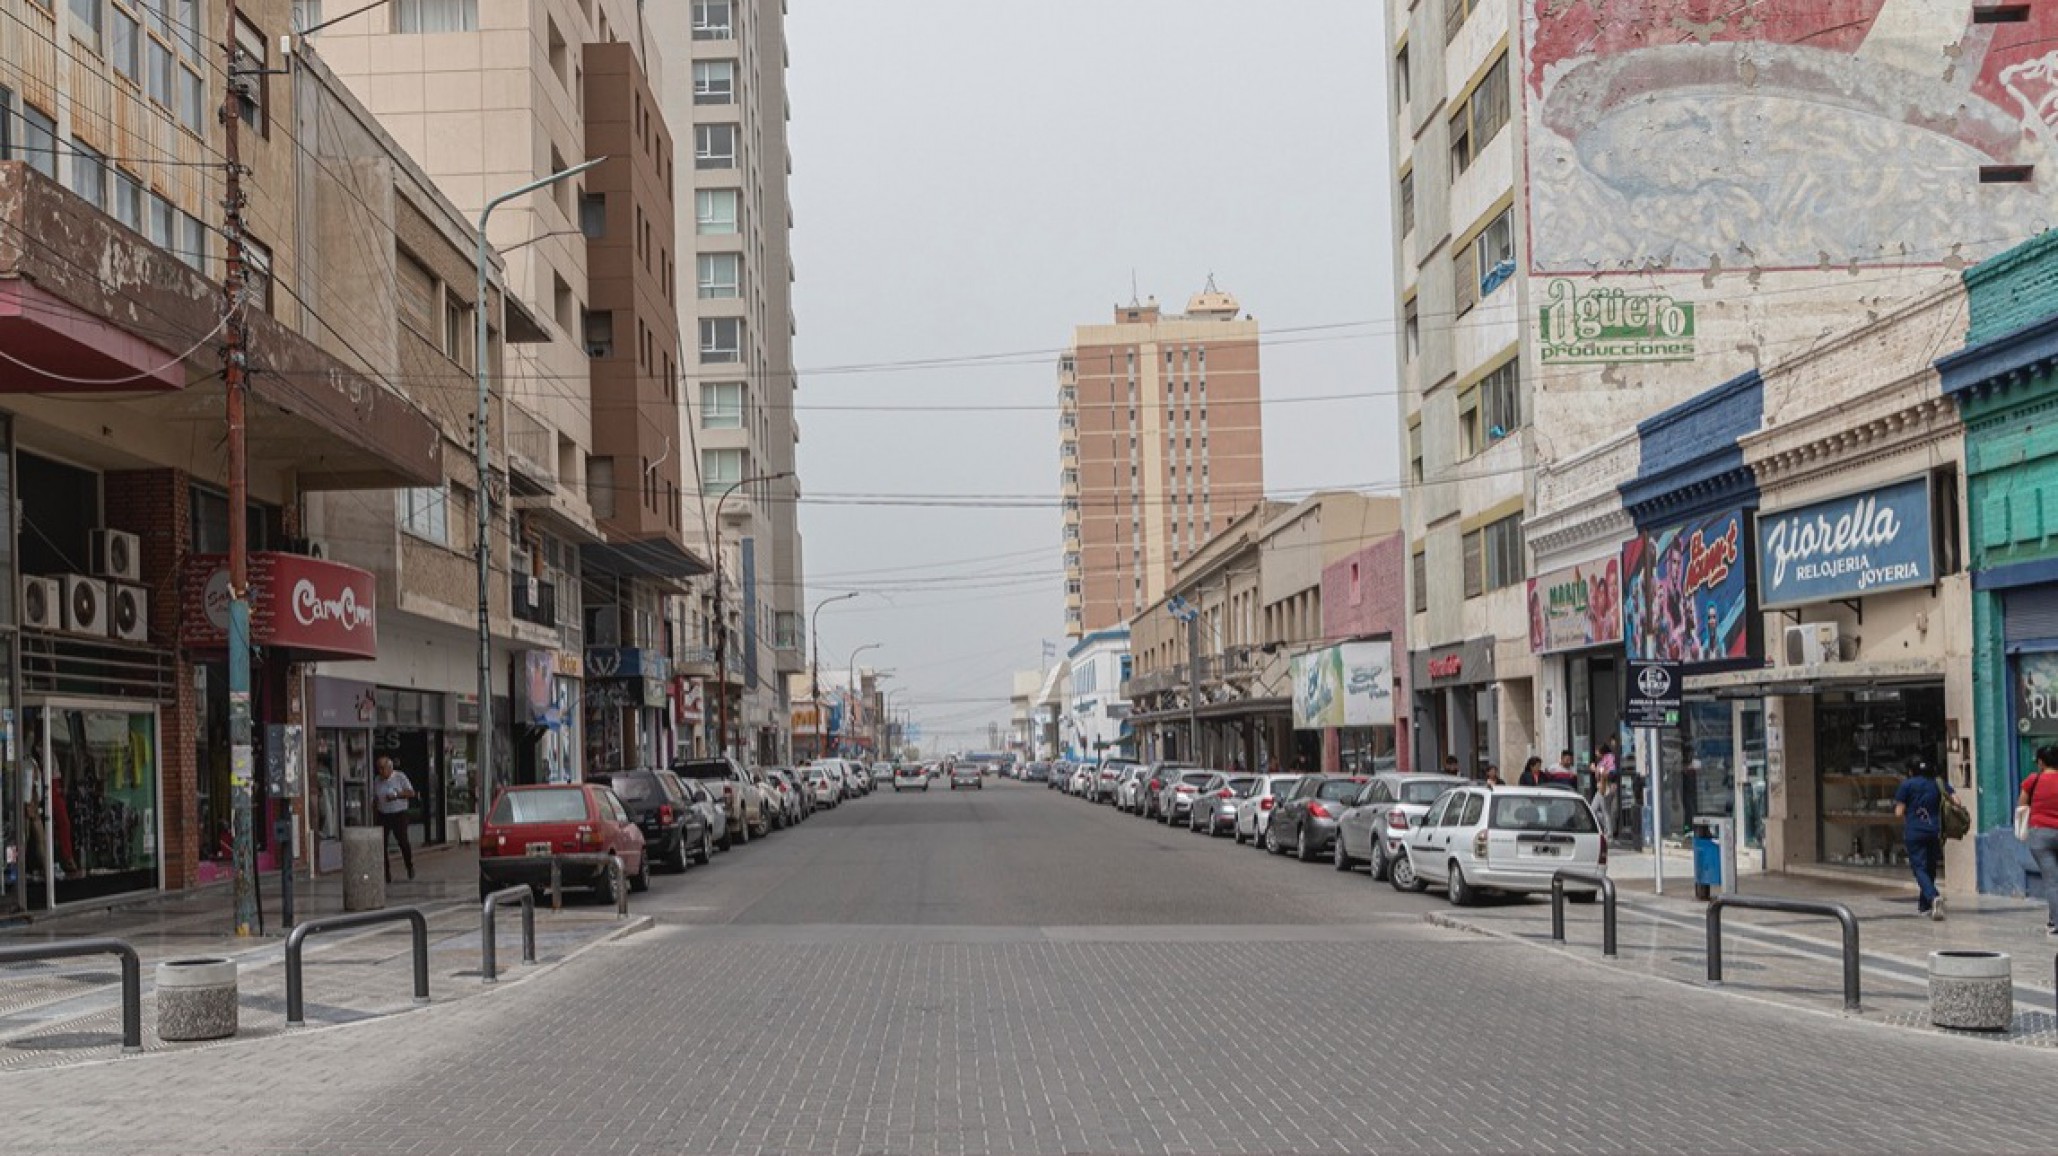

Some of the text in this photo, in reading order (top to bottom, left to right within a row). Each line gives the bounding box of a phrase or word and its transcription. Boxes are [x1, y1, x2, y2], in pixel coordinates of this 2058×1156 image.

[1548, 278, 1687, 346] Agüero
[1541, 342, 1695, 361] producciones
[1796, 554, 1870, 581] RELOJERIA
[1858, 562, 1919, 589] JOYERIA
